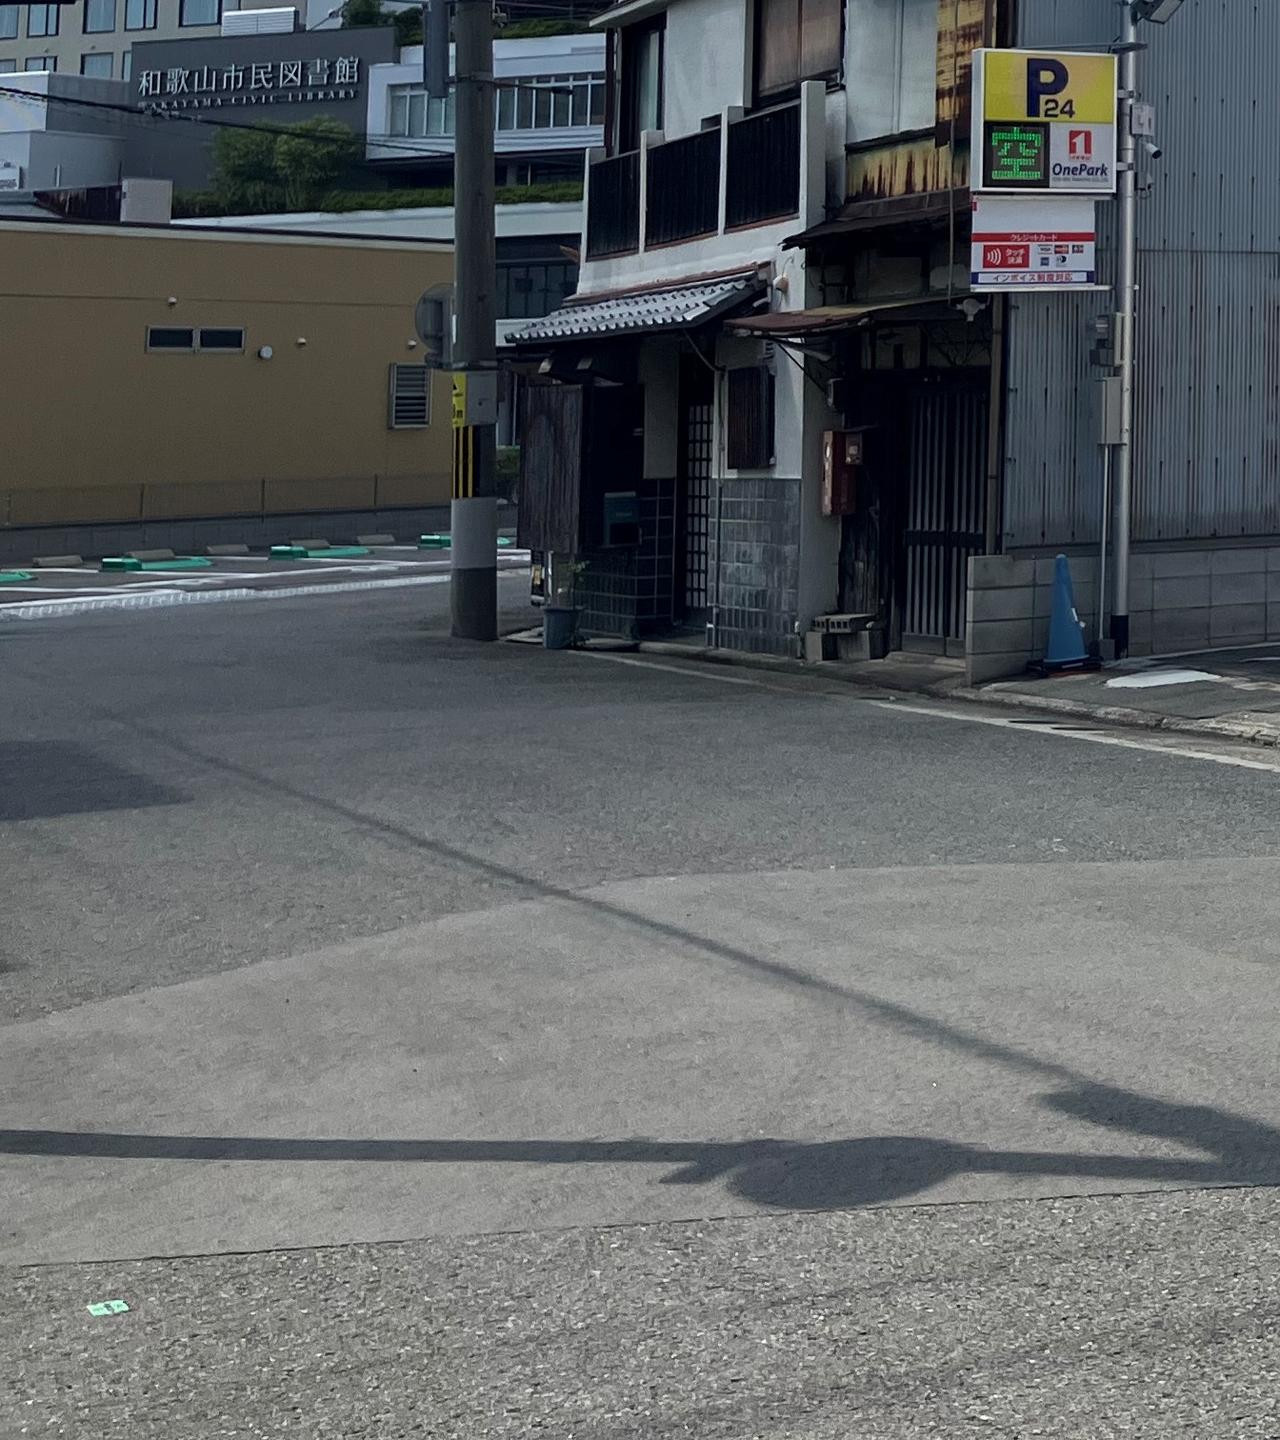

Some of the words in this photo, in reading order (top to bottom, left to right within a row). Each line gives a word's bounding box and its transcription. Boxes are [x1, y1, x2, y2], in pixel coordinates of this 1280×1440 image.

[138, 56, 359, 97] 和歌山市民図書館
[288, 89, 357, 102] LIBRARY
[1026, 58, 1069, 118] P
[1044, 98, 1075, 118] 24
[1052, 163, 1108, 176] OnePark
